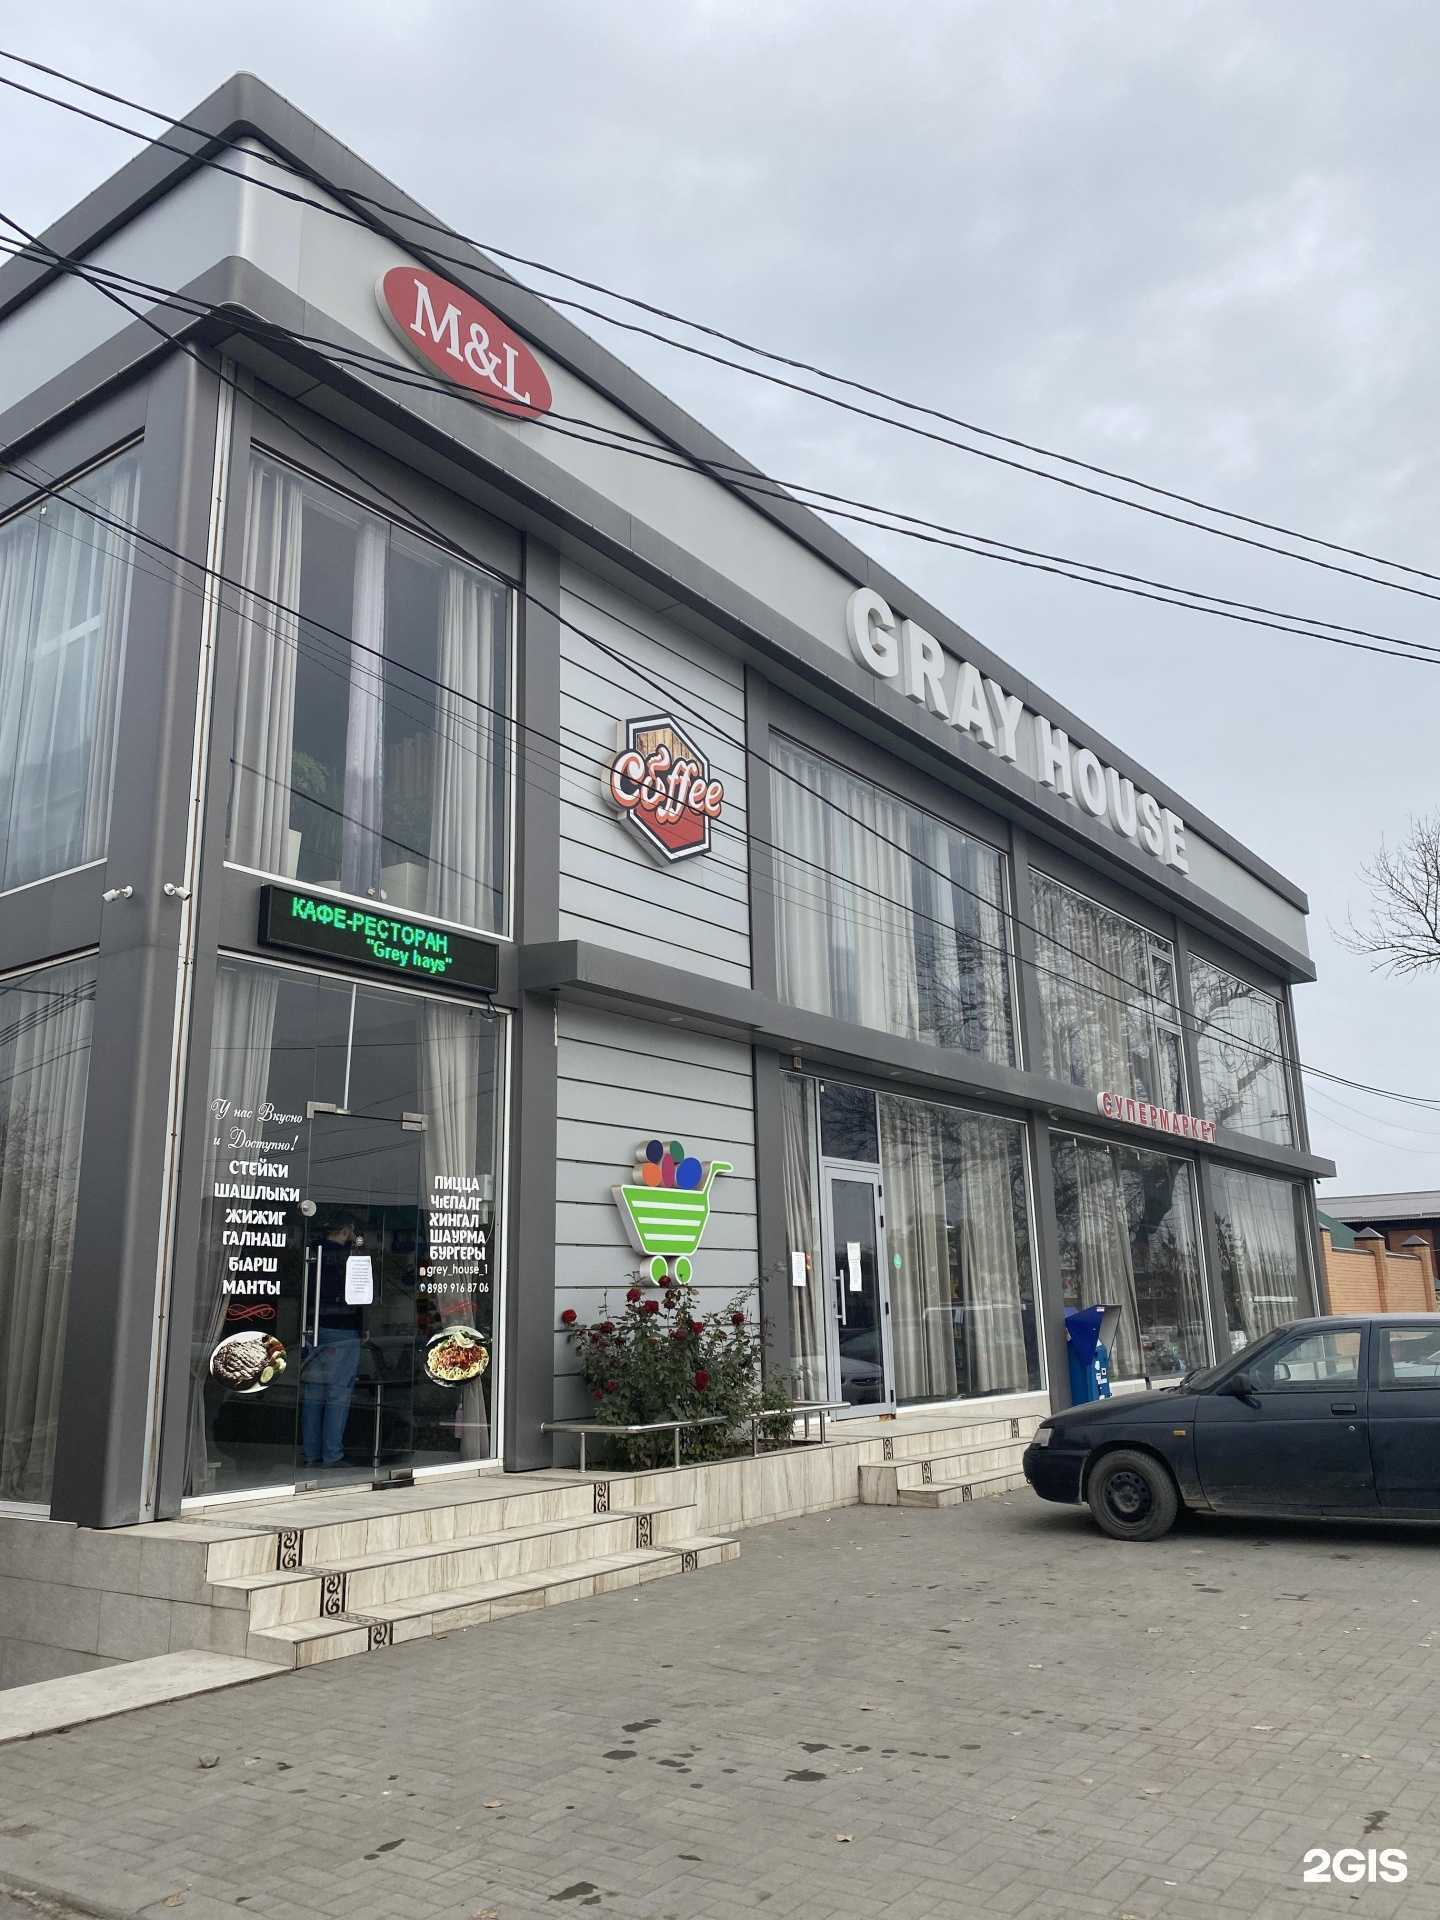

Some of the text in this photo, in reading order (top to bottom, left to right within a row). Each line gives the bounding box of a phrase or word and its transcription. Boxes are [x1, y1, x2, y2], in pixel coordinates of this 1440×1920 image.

[410, 278, 531, 405] M&L
[846, 586, 1190, 876] GRAY HOUSE
[610, 743, 725, 825] Coffee
[291, 896, 449, 954] КАФЕ-РЕСТОРАН
[233, 1108, 253, 1119] нас
[257, 1102, 303, 1125] Вкусно
[1097, 1091, 1217, 1144] СУПЕРМАРКЕТ
[213, 1137, 221, 1146] и
[229, 1157, 289, 1179] СТЕЙКИ
[214, 1182, 300, 1202] ШАШЛЫКИ
[434, 1175, 480, 1194] ПИЦЦА
[225, 1208, 287, 1226] ЖИЖИГ
[429, 1212, 480, 1228] ХИНГАЛ
[222, 1230, 287, 1248] ГАЛНАШ
[429, 1229, 487, 1245] ШАУРМА
[429, 1245, 486, 1261] БУРГЕРЫ
[222, 1279, 281, 1296] МАНТЫ
[427, 1282, 490, 1294] 8989 916 87 06
